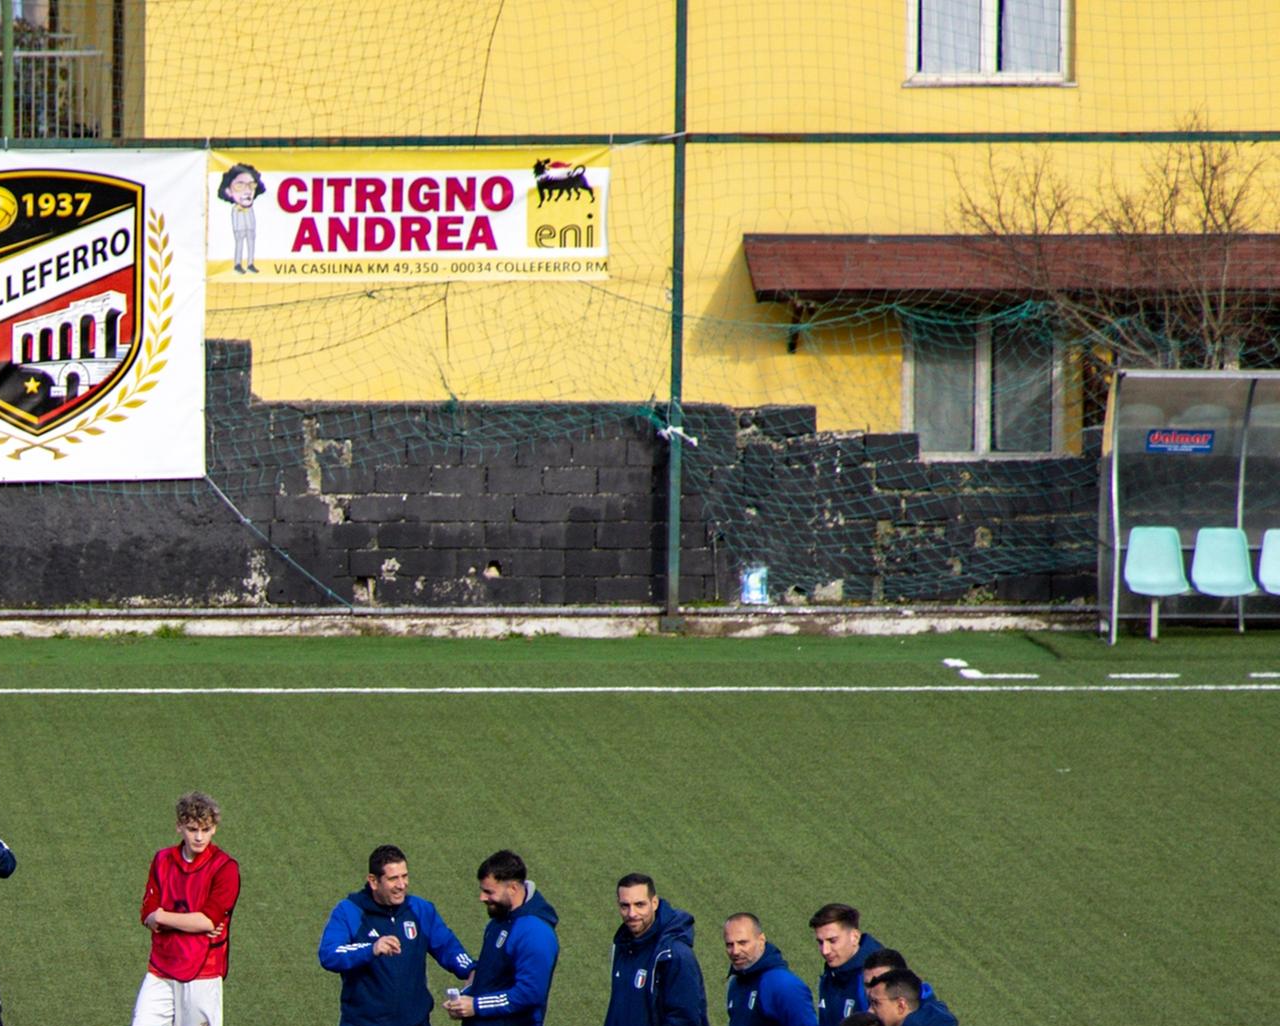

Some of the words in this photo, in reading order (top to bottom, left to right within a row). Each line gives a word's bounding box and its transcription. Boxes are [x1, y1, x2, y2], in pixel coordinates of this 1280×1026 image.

[22, 193, 92, 217] 1937
[277, 176, 514, 213] CITRIGNO
[291, 216, 498, 252] ANDREA
[534, 213, 594, 248] eni
[274, 263, 297, 274] VIA
[301, 263, 364, 274] CASILINA
[368, 263, 390, 274] KM
[393, 262, 439, 275] 49,350
[451, 262, 492, 273] 00034
[495, 262, 582, 273] COLLEFERRO
[586, 261, 608, 272] RM
